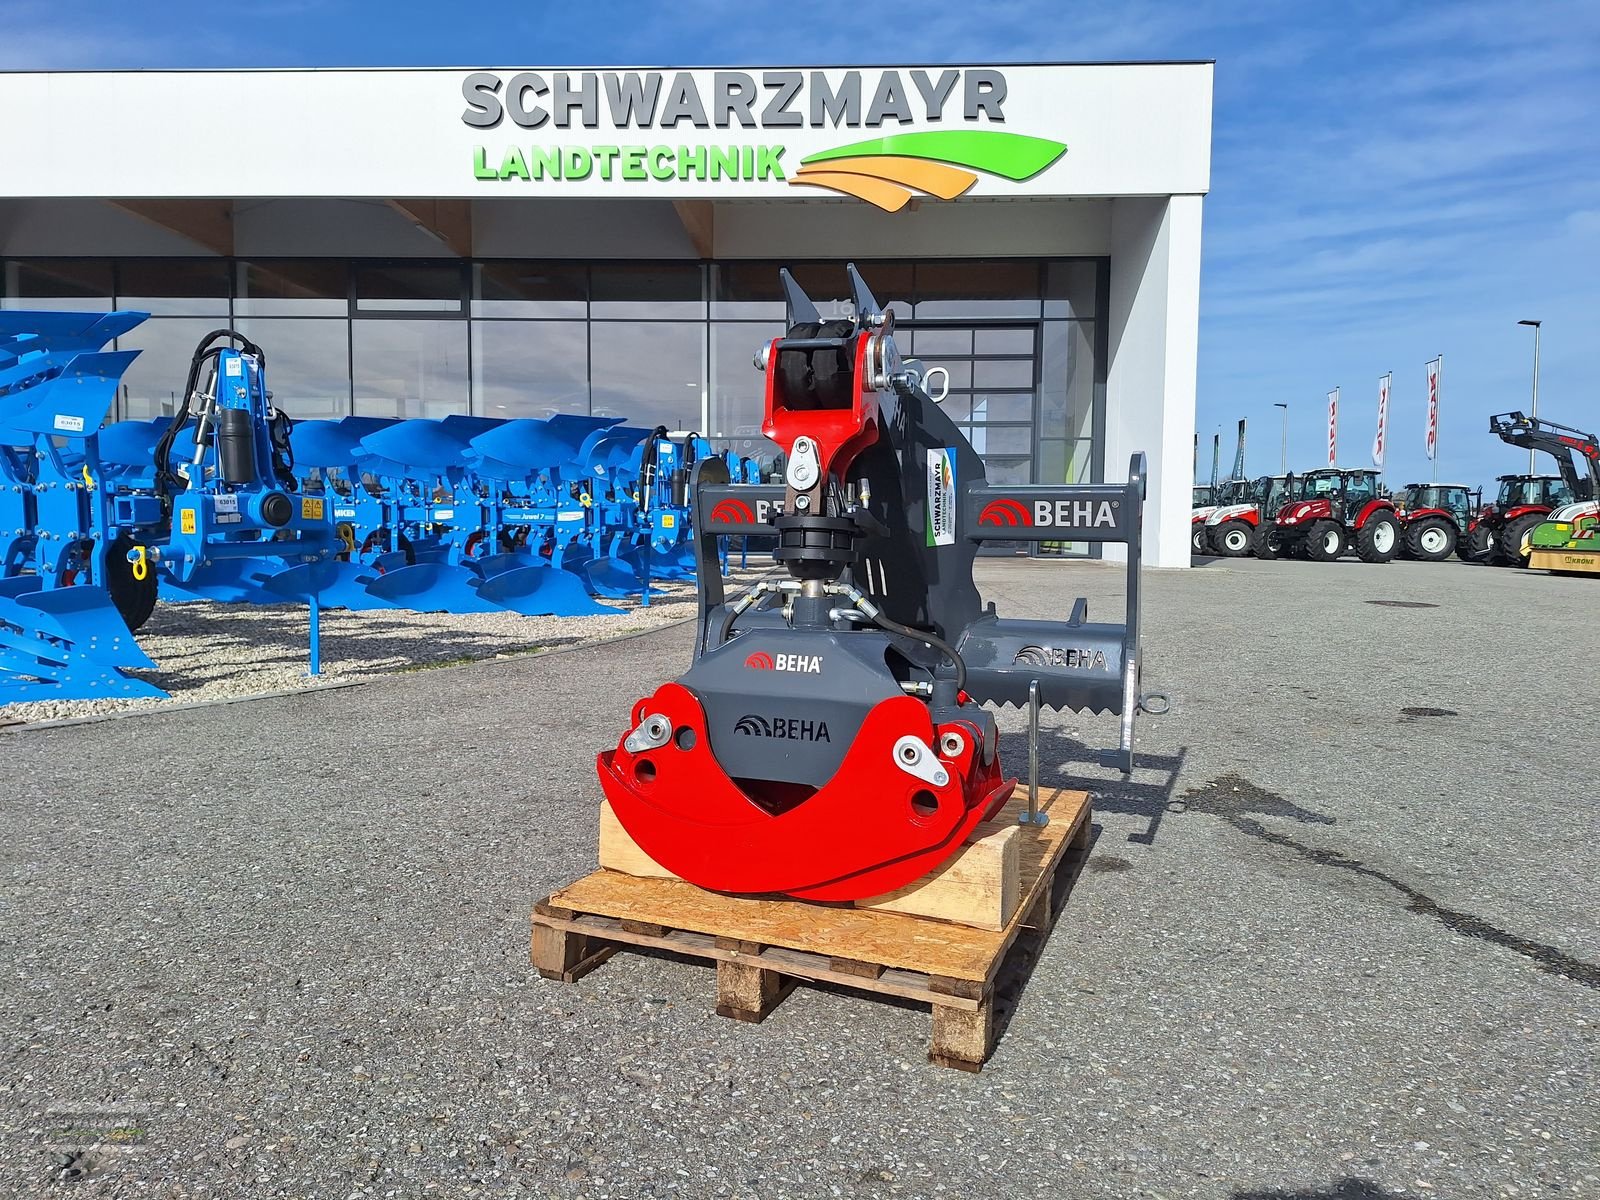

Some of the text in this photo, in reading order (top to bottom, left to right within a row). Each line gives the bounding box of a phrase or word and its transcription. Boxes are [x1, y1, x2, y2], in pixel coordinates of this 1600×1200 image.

[461, 70, 1008, 129] SCHWARZMAYR
[473, 144, 788, 182] LANDTECHNIK
[772, 717, 831, 743] BEHA
